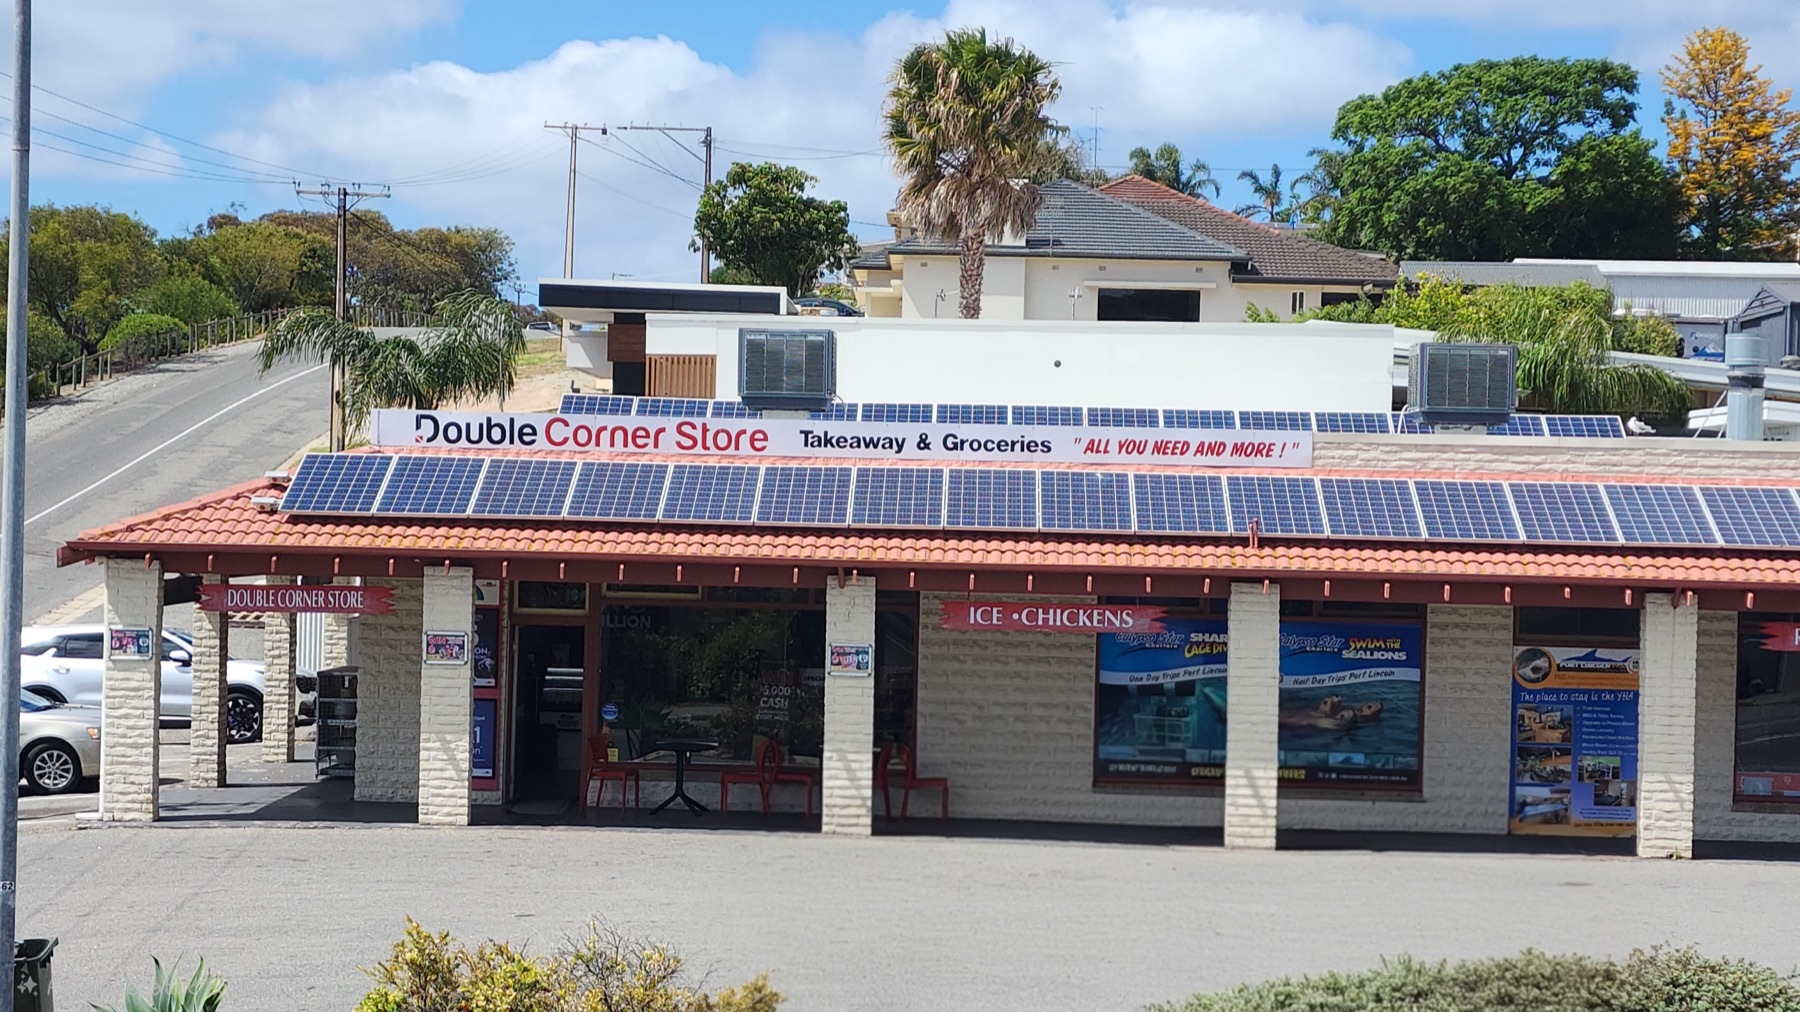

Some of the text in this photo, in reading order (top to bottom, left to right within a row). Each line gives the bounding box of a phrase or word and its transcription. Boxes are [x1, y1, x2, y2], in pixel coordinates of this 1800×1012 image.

[415, 413, 769, 453] Double Corner Store
[799, 429, 1053, 455] Takeaway & Groceries
[1116, 438, 1147, 457] YOU
[1151, 439, 1191, 458] NEED
[1193, 440, 1227, 458] AND
[227, 588, 364, 609] DOUBLE CORNER STORE
[969, 606, 1003, 625] ICE
[1115, 631, 1185, 646] Calypso Star
[1317, 634, 1345, 648] Star
[1349, 637, 1386, 651] SWIM
[1184, 642, 1212, 659] CAGE
[1342, 650, 1408, 661] SEALIONS
[1129, 675, 1144, 683] One
[1146, 673, 1160, 682] Day
[1162, 672, 1180, 680] Trips
[1182, 669, 1200, 677] Port
[1293, 669, 1396, 685] Half Day Trips Port Lincoln
[1520, 691, 1634, 703] The place to stay is the YHA
